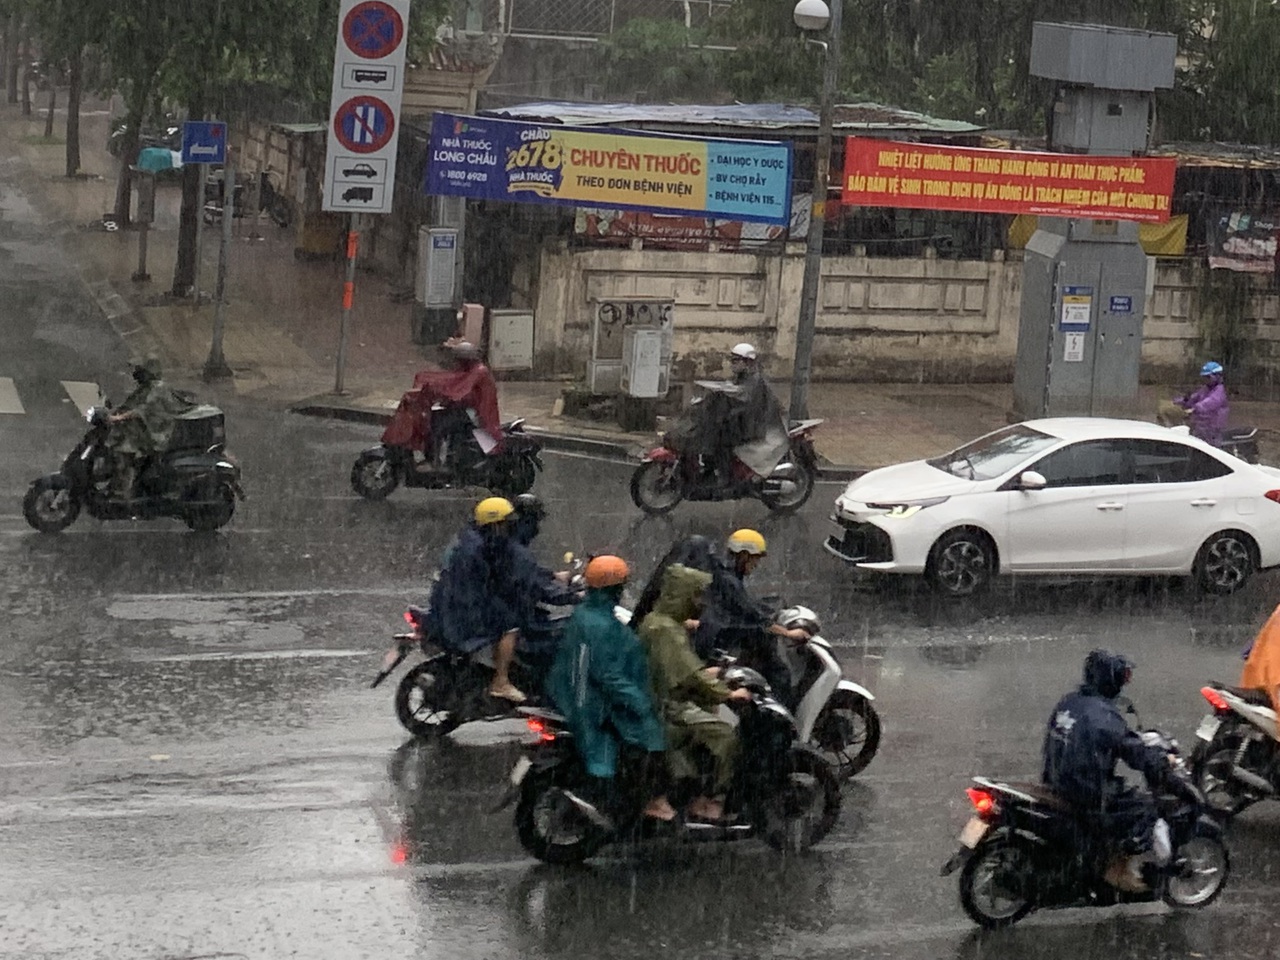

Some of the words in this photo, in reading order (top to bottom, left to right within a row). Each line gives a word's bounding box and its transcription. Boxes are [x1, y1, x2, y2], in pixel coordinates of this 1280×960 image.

[433, 150, 465, 162] LONG
[467, 151, 497, 166] CHÂU
[570, 148, 640, 171] CHUYÊN
[643, 152, 701, 175] THUỐC
[733, 157, 752, 168] HỌC
[753, 158, 761, 167] Y
[447, 170, 465, 179] 1800
[716, 173, 728, 183] BV
[576, 175, 605, 188] THEO
[633, 178, 664, 195] BỆNH
[666, 181, 693, 198] VIỆN
[923, 179, 951, 197] TRONG
[715, 190, 739, 203] BỆNH
[740, 192, 761, 205] VIỆN
